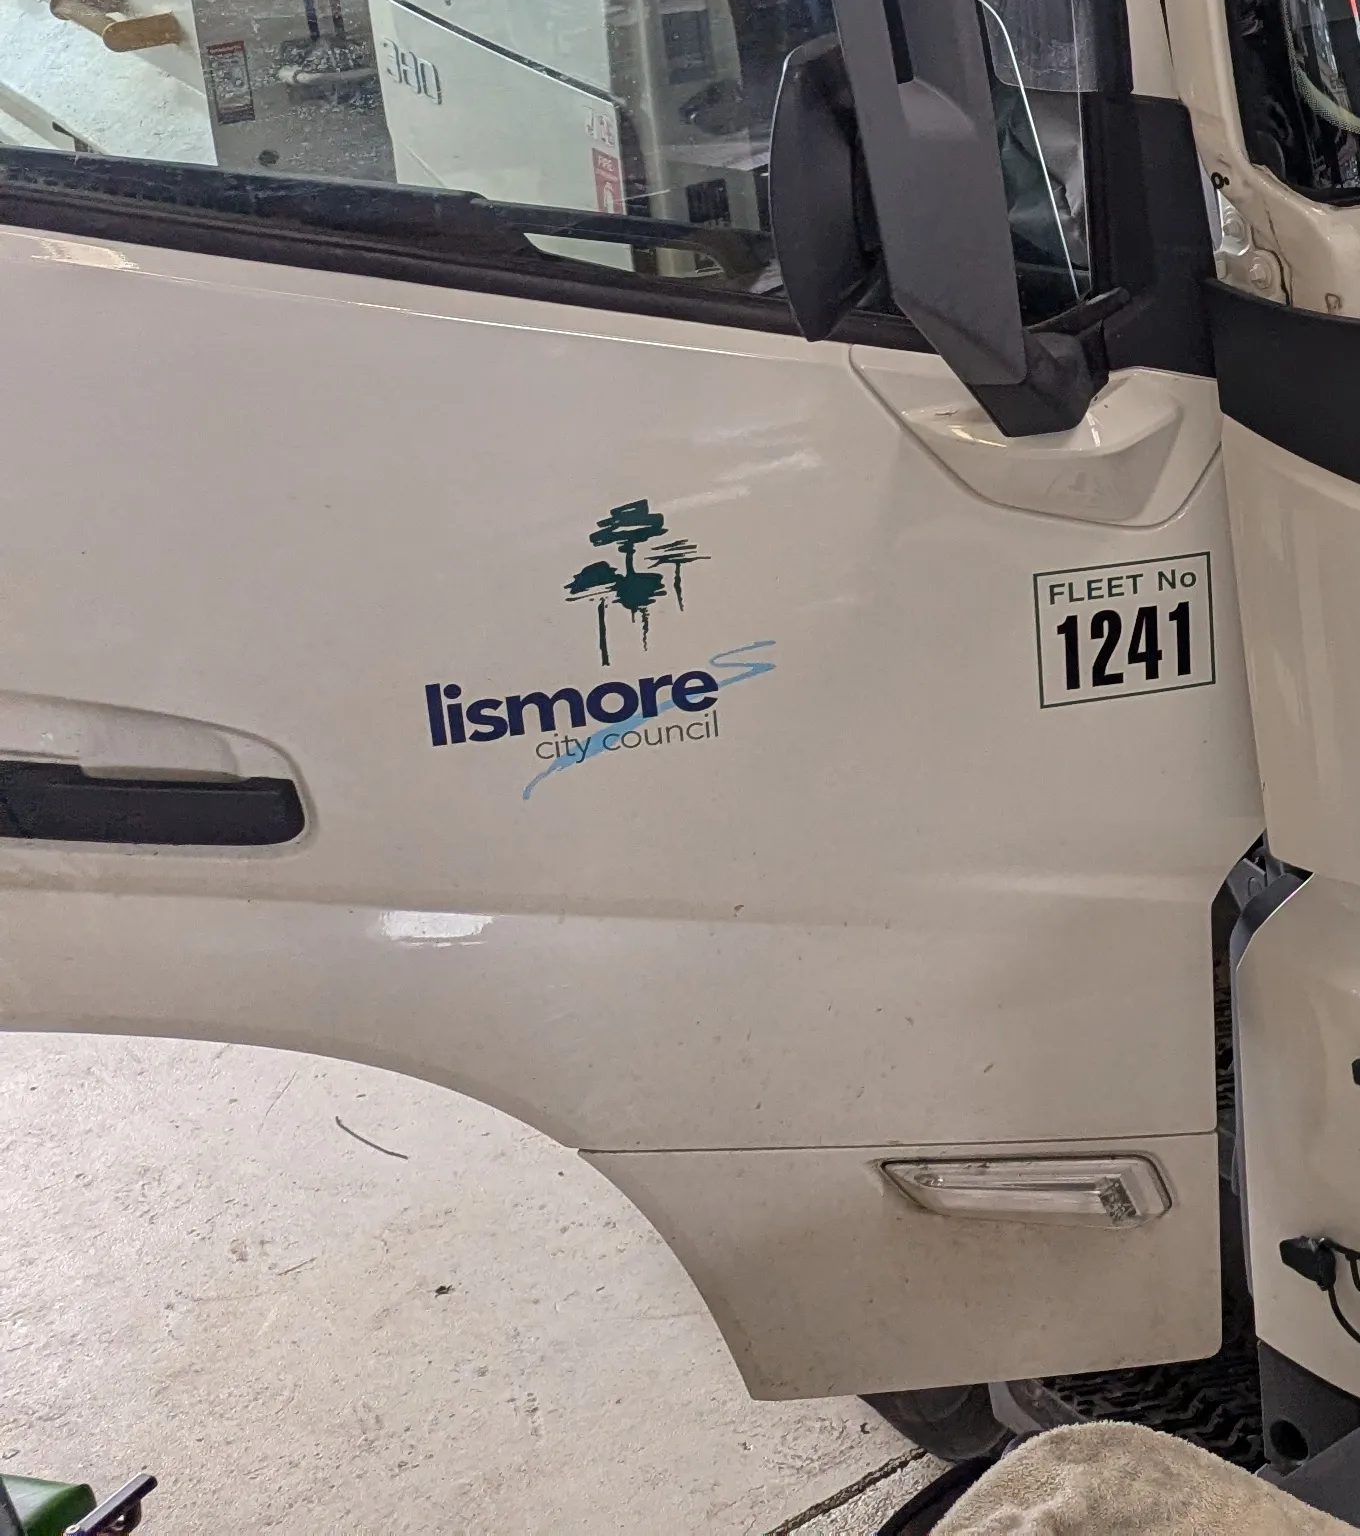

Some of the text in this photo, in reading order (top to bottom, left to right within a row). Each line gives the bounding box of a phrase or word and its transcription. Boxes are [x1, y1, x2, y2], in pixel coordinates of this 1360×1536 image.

[1049, 568, 1197, 606] FLEET No
[1056, 600, 1192, 691] 1241
[425, 670, 719, 747] lismore
[535, 710, 720, 764] city council
